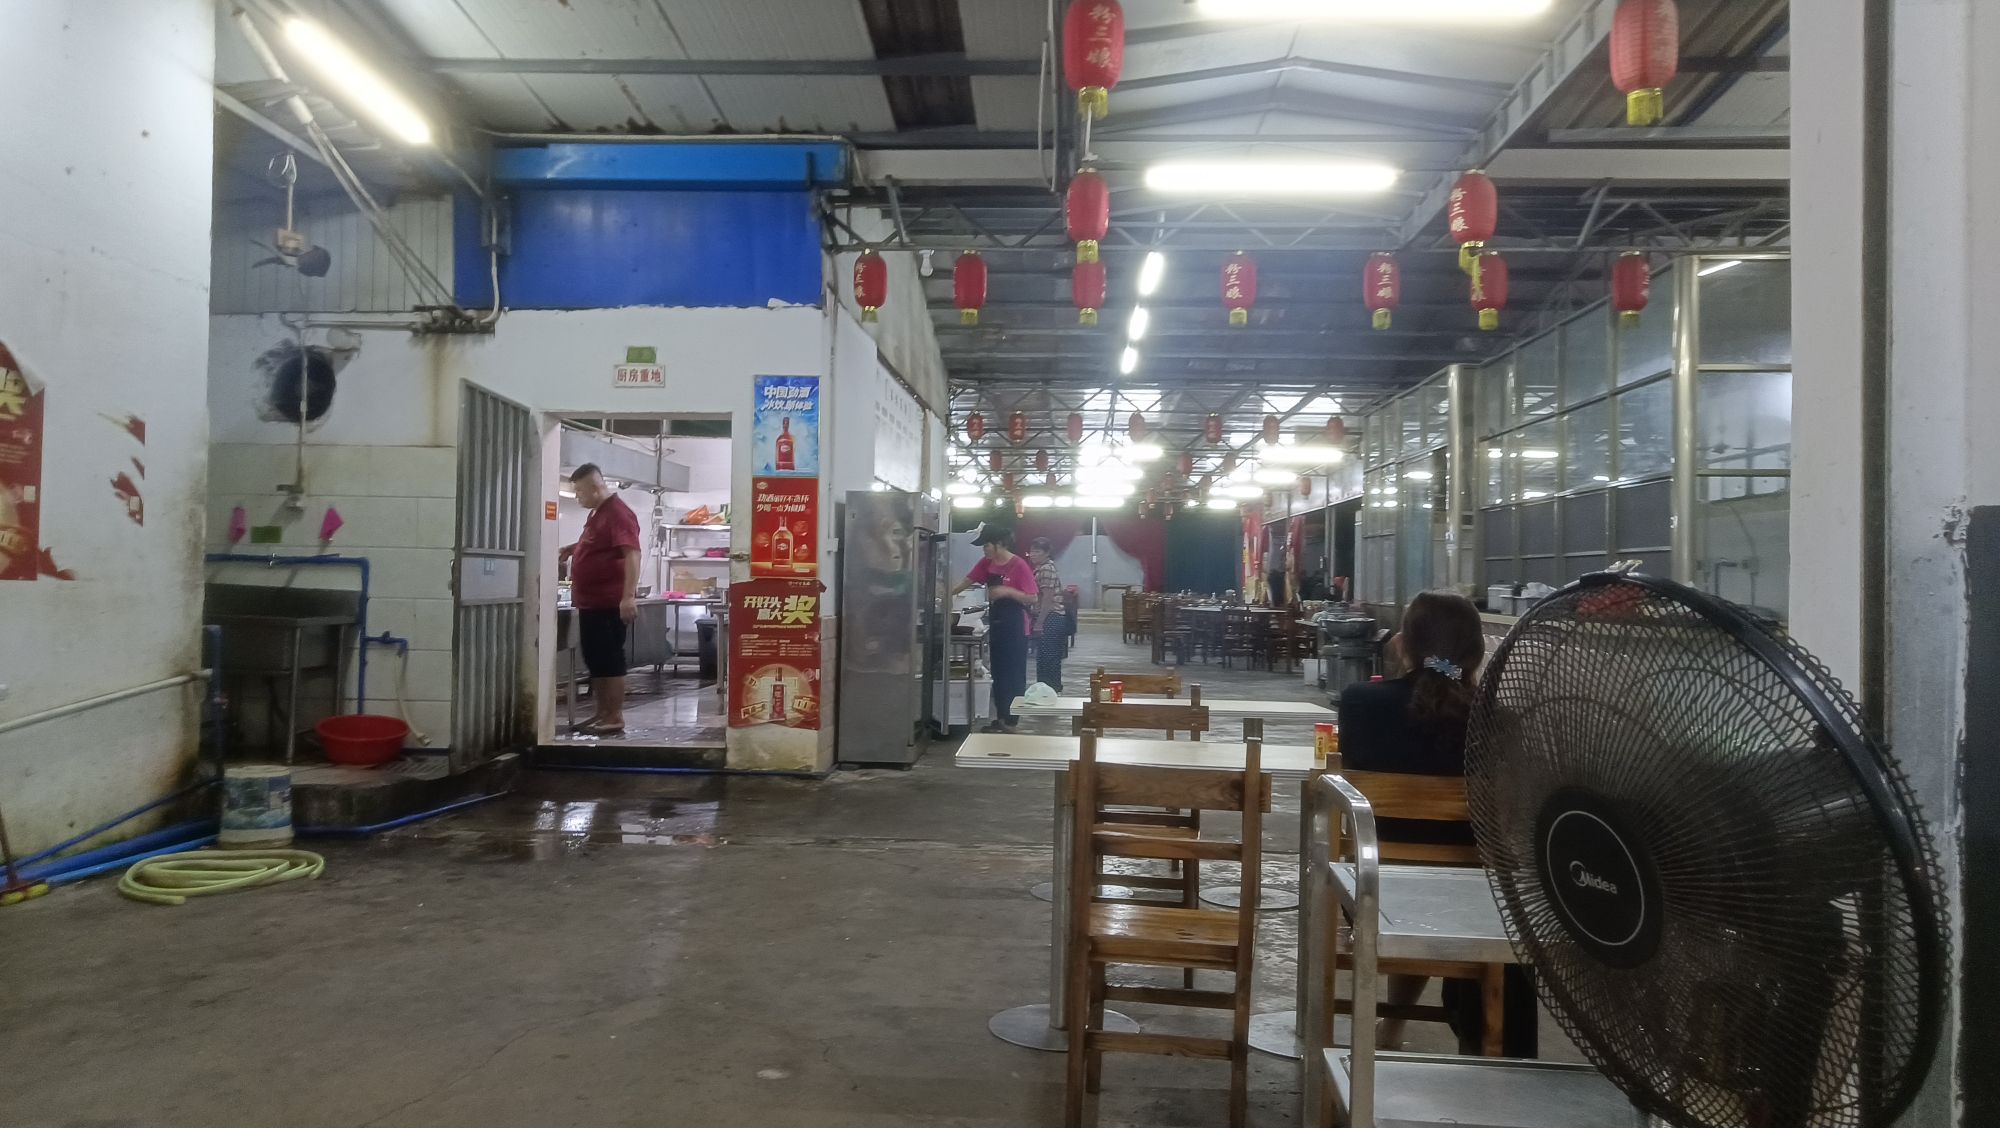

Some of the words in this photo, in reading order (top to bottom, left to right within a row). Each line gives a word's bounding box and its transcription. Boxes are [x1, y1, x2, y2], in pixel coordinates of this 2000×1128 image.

[617, 368, 661, 382] 厨房重地
[743, 596, 782, 608] 开好头
[781, 594, 817, 624] 奖
[1579, 869, 1618, 894] Midea
